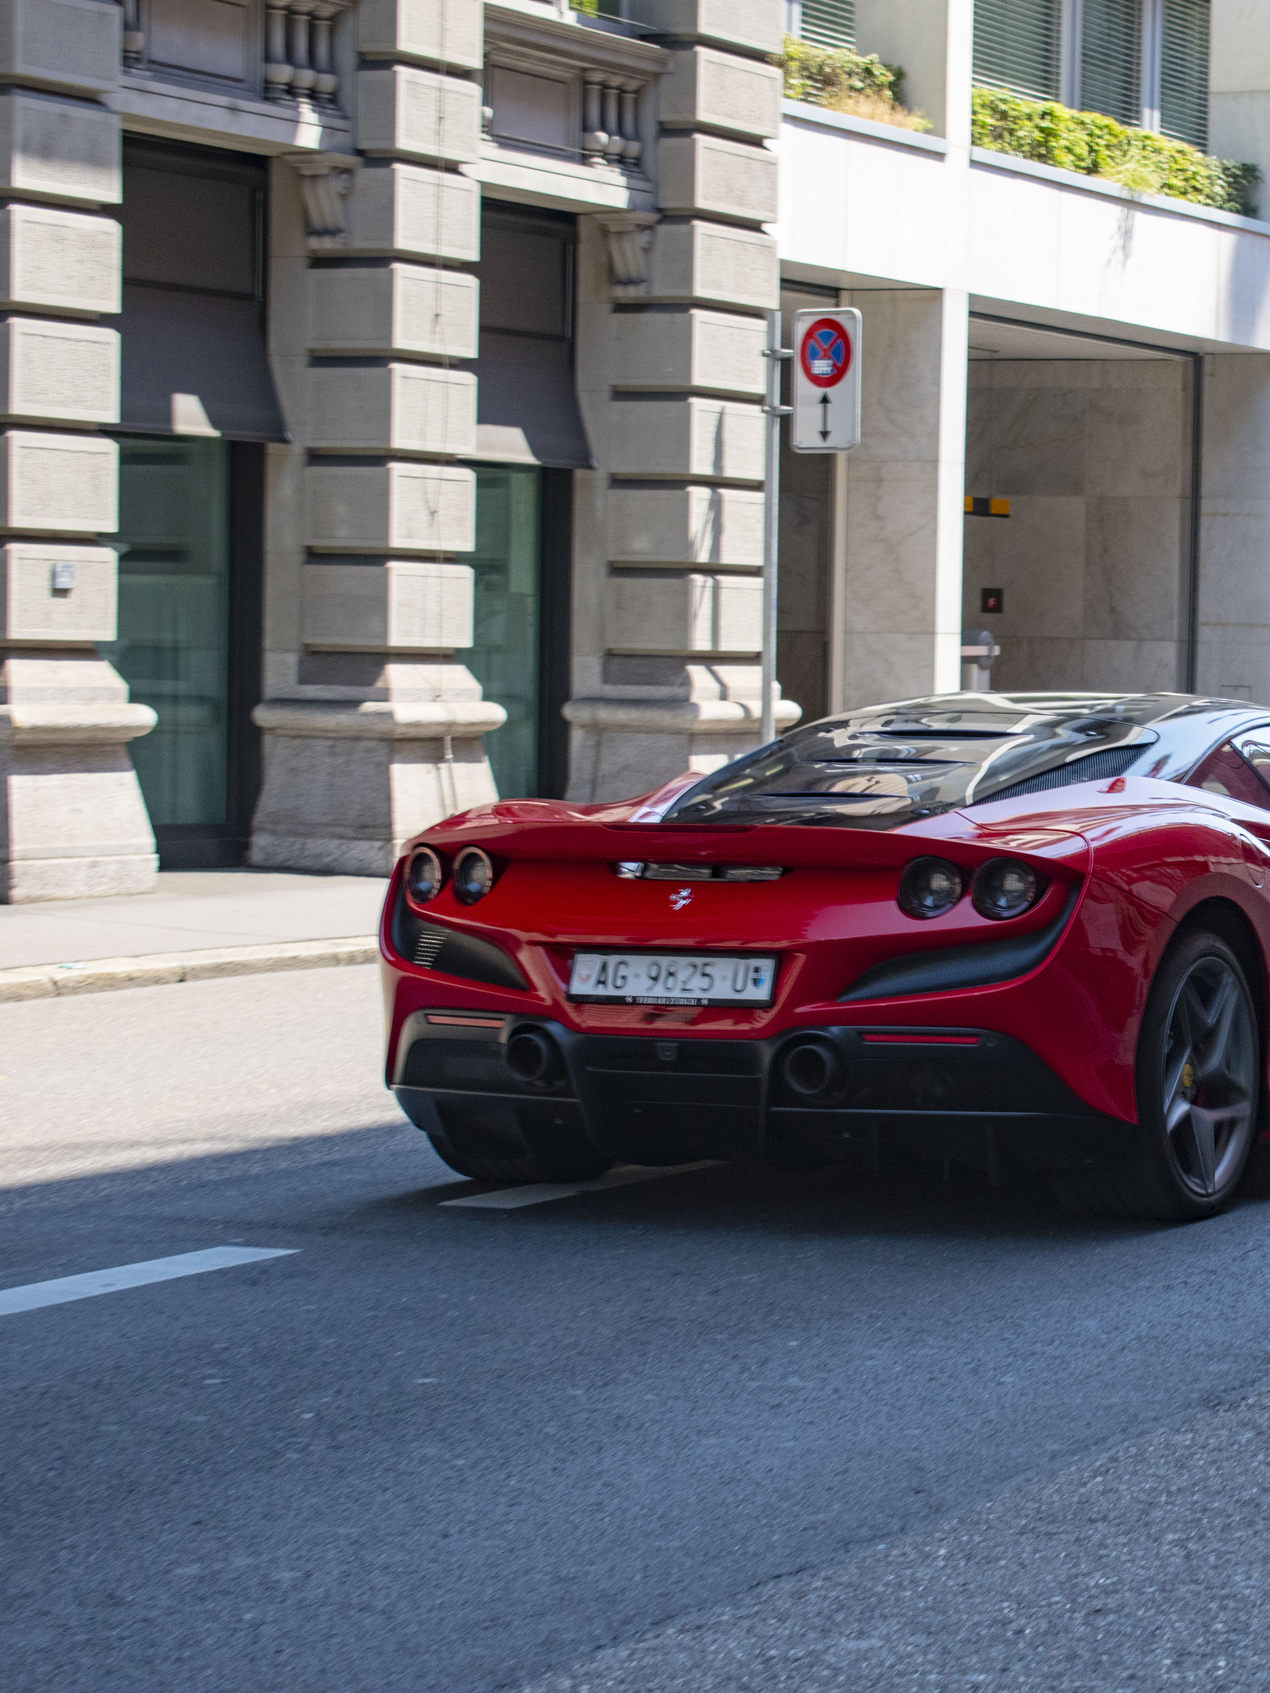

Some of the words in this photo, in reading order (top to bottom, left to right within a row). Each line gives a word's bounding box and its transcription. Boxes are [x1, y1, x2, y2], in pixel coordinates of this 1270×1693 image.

[594, 959, 629, 990] AG
[646, 960, 716, 993] 9825
[731, 962, 750, 994] U
